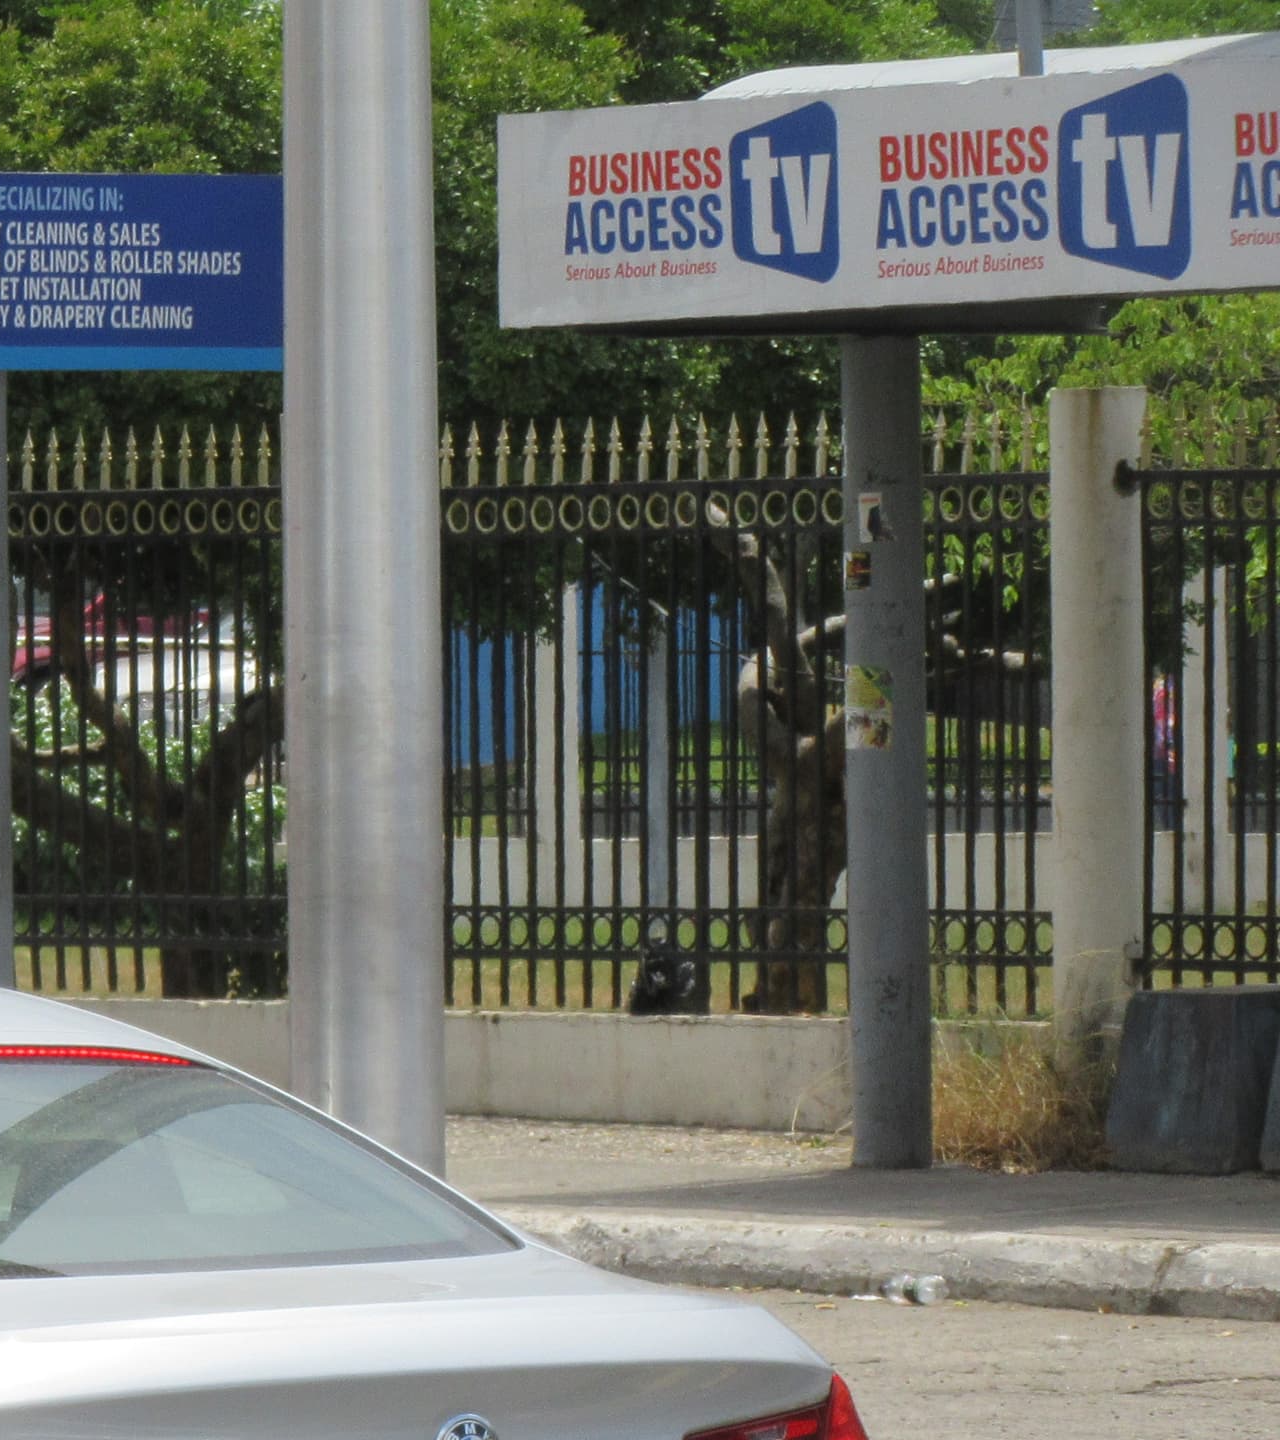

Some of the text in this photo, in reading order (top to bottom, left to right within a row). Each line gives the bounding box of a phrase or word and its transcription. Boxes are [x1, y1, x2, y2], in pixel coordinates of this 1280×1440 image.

[879, 125, 1050, 183] BUSINESS
[569, 146, 723, 197] BUSINESS
[1072, 113, 1181, 250] tv
[99, 188, 124, 212] IN:
[742, 136, 831, 256] tv
[564, 193, 725, 256] ACCESS
[876, 178, 1050, 250] ACCESS
[6, 221, 89, 247] CLEANING
[92, 222, 106, 246] &
[109, 222, 161, 247] SALES
[3, 249, 27, 273] OF
[30, 249, 90, 274] BLINDS
[93, 250, 107, 273] &
[111, 251, 173, 275] ROLLER
[177, 251, 242, 276] SHADES
[565, 259, 718, 282] Serious About Business
[878, 254, 1045, 278] Serious About Business
[23, 277, 141, 302] INSTALLATION
[13, 304, 27, 328] &
[30, 305, 106, 329] DRAPERY
[110, 306, 193, 330] CLEANING
